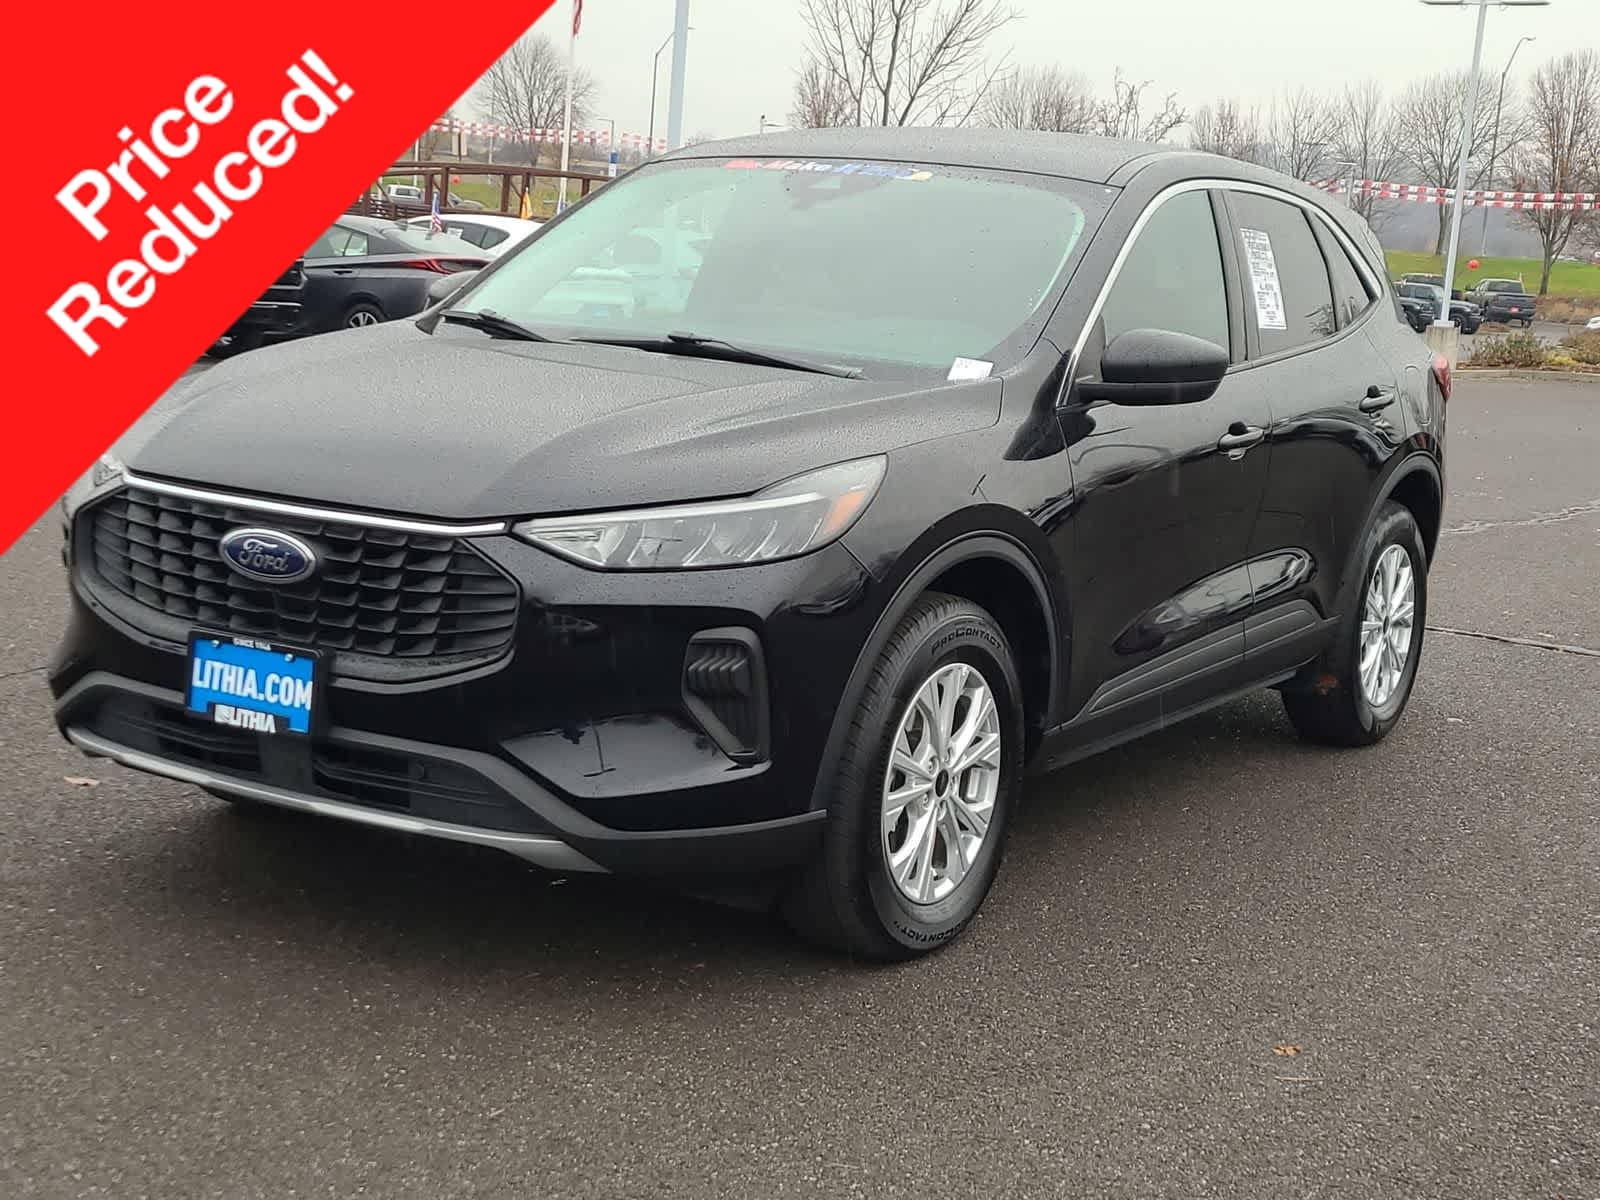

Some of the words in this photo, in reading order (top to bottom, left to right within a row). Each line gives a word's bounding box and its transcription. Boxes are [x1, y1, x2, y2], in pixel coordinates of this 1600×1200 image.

[239, 538, 289, 572] Ford
[191, 657, 313, 711] LITHIA.COM
[228, 706, 276, 733] LITHIA
